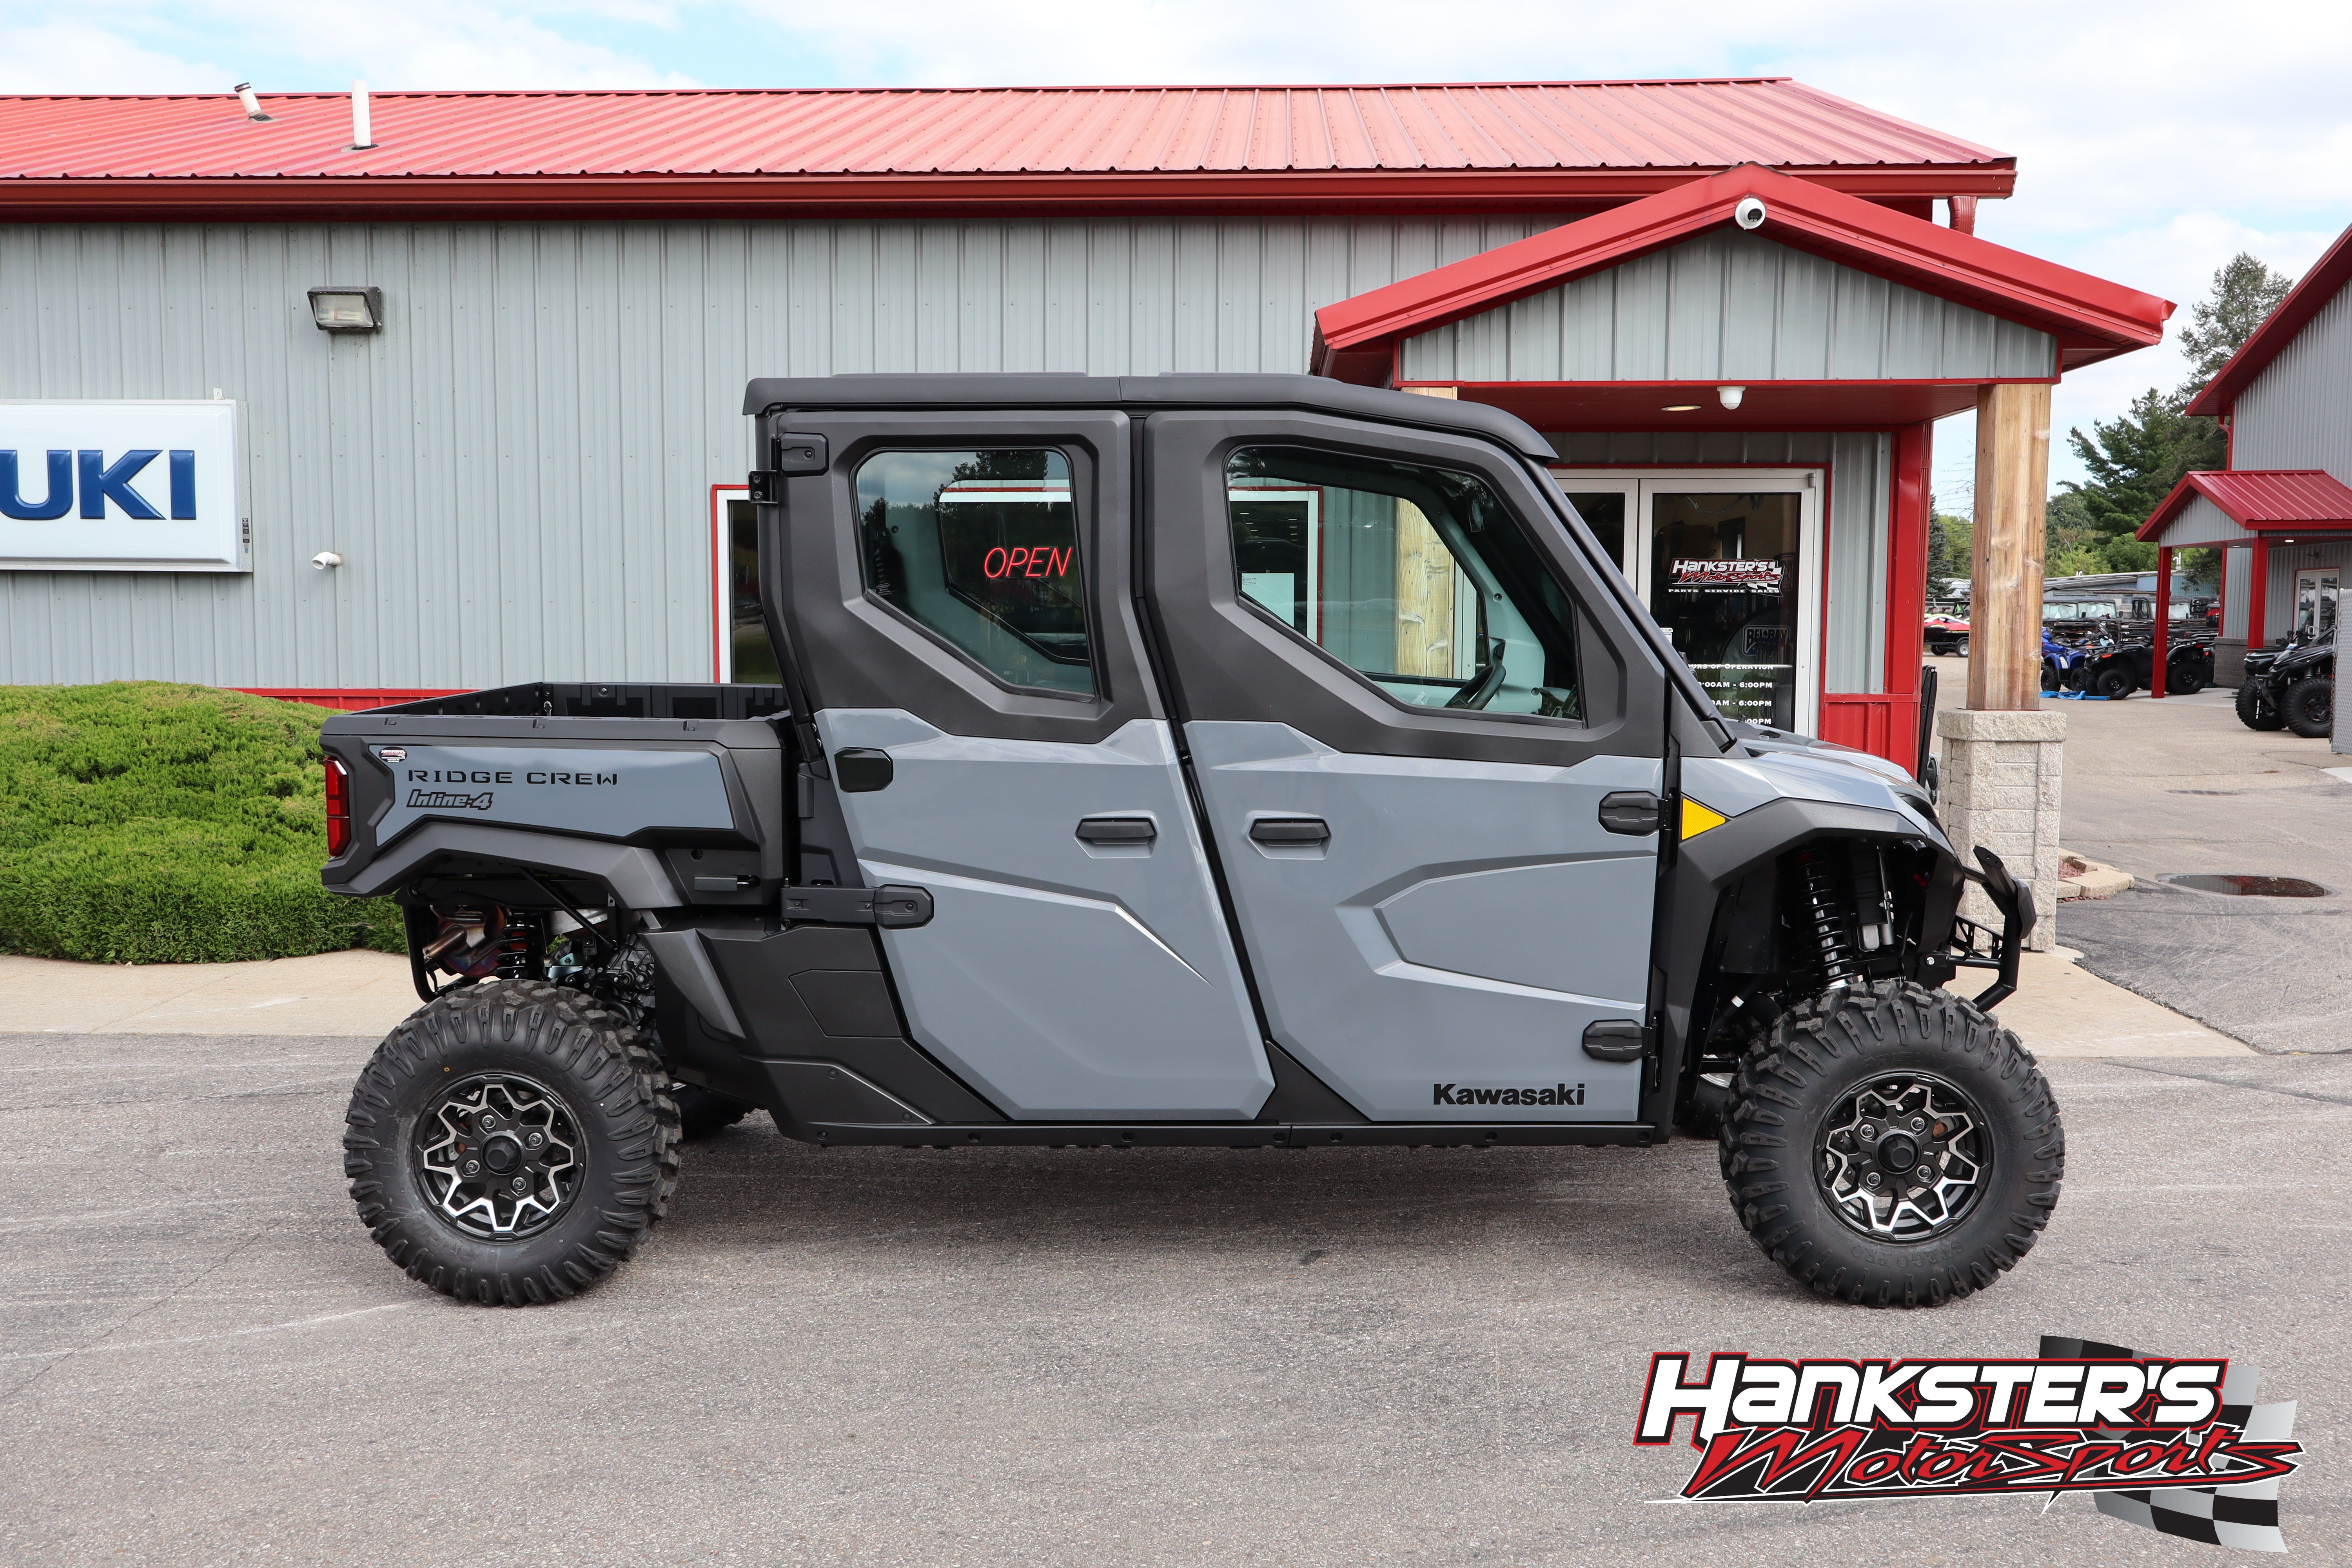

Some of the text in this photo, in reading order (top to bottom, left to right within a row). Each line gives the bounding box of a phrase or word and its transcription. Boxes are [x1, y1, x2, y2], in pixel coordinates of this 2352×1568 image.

[0, 450, 196, 520] UKI
[984, 547, 1073, 578] OPEN
[408, 770, 617, 785] RIDGE CREW
[406, 789, 494, 810] Inline-4
[1433, 1083, 1585, 1105] Kawasaki
[1851, 1241, 1964, 1269] STEGO PRO
